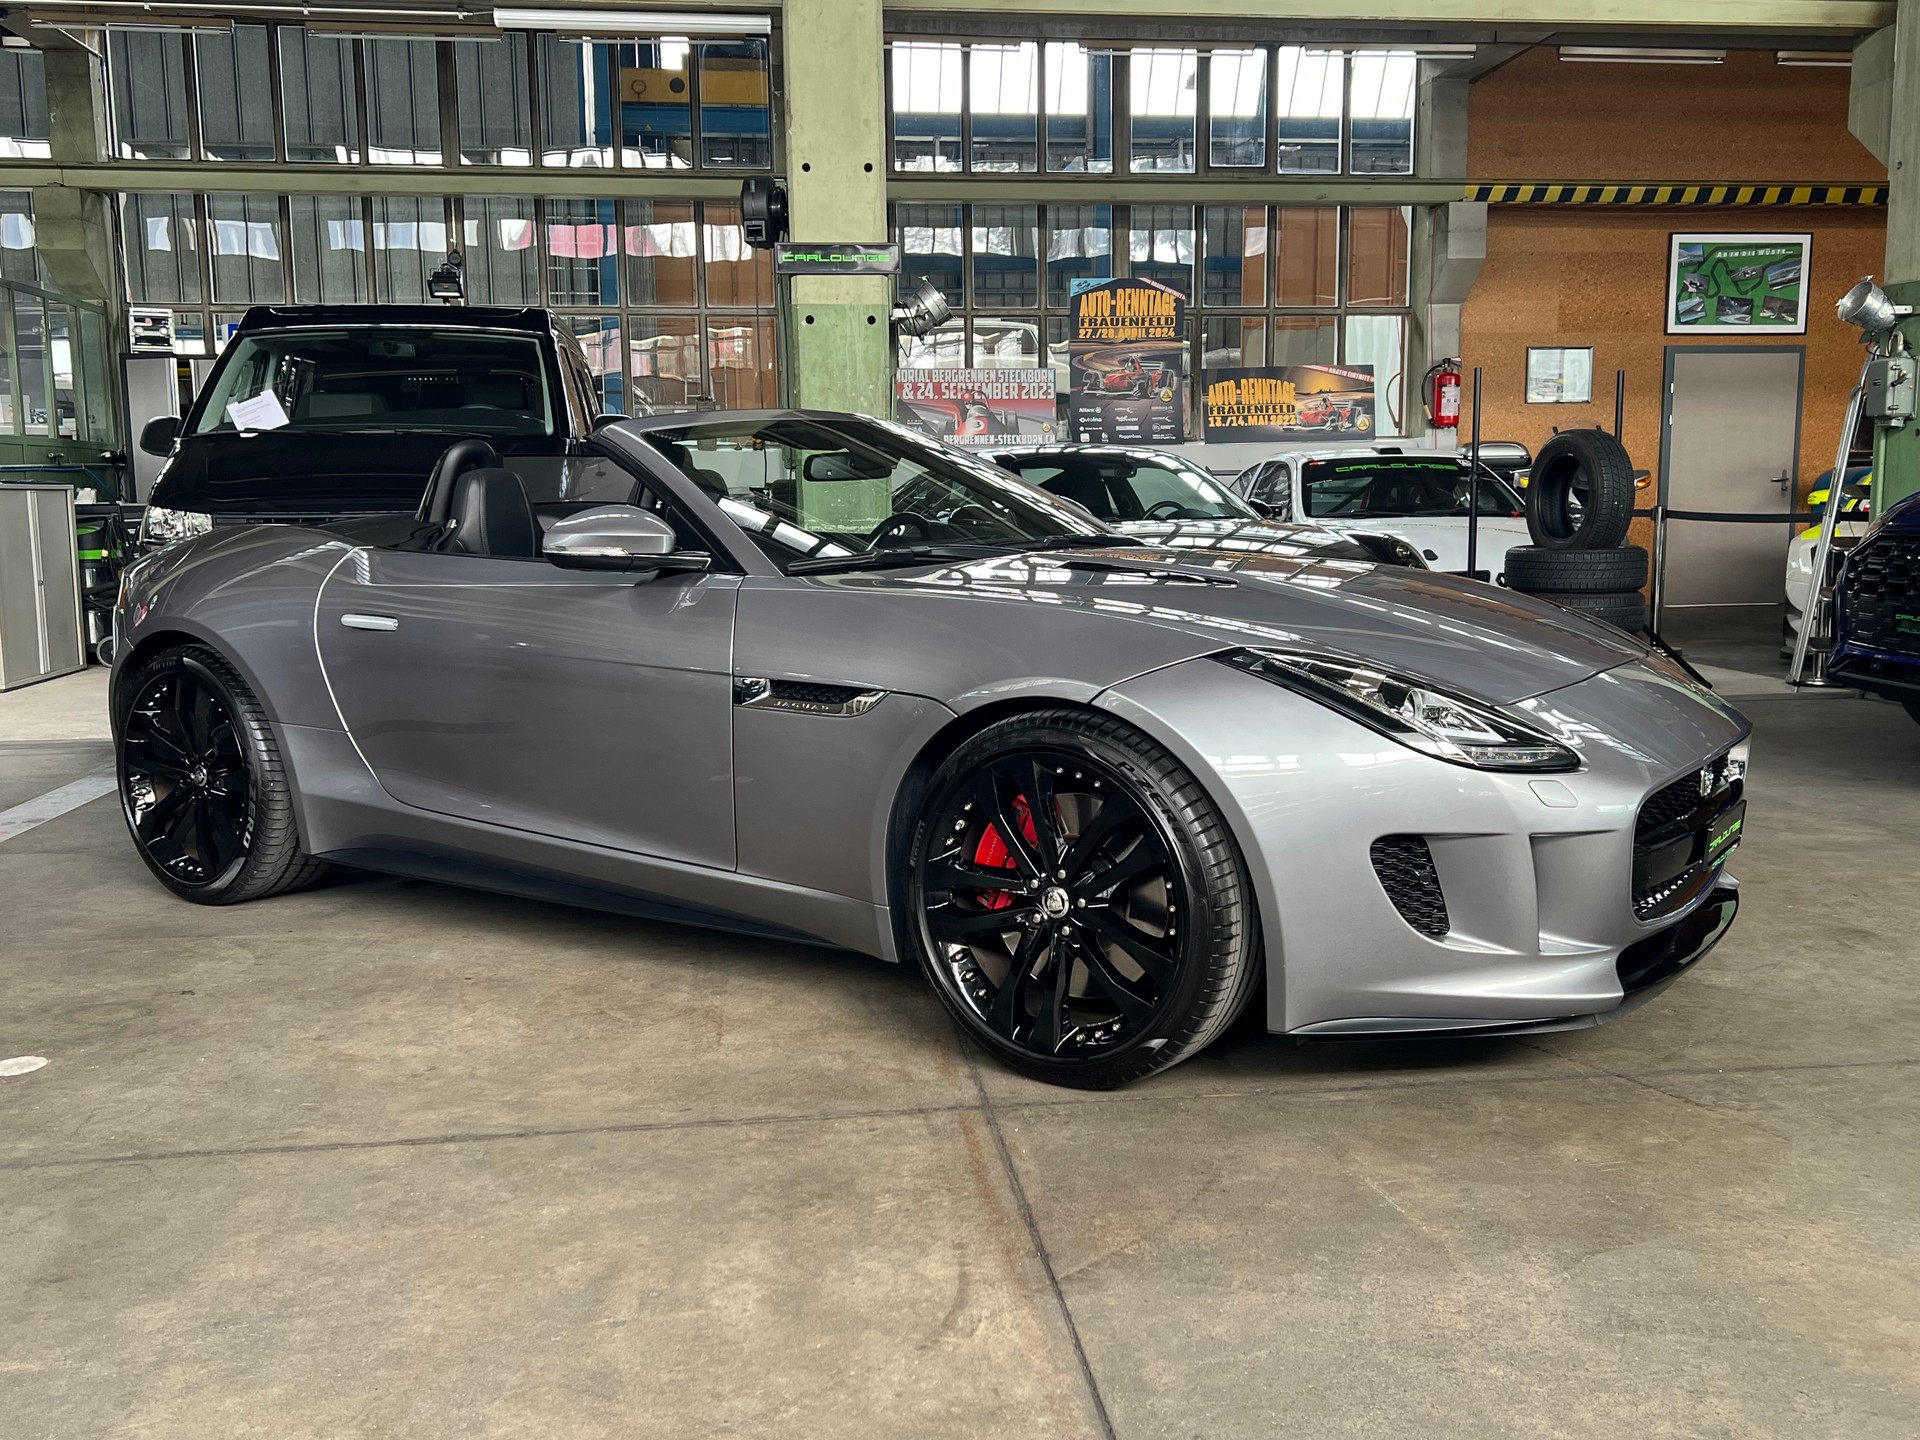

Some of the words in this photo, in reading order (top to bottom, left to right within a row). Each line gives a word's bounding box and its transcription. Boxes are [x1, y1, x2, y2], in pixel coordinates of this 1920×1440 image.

[782, 254, 890, 262] CARLOUNGE
[1079, 288, 1176, 317] AUTO-RENNTAGE
[1080, 317, 1175, 327] FRAUENFELD
[1148, 327, 1176, 338] 2024
[932, 369, 996, 383] BERGRENNEN
[998, 369, 1055, 383] STECKBORN
[902, 383, 914, 400] &
[916, 383, 939, 400] 24.
[1021, 383, 1055, 400] 2023
[1208, 378, 1297, 406] AUTO-RENNTAGE
[1209, 405, 1296, 415] FRAUENFELD
[1270, 415, 1297, 427] 2023
[944, 434, 1056, 445] BERGRENNEN-STECKBORN.CH
[1335, 463, 1459, 473] CARLOUNGE
